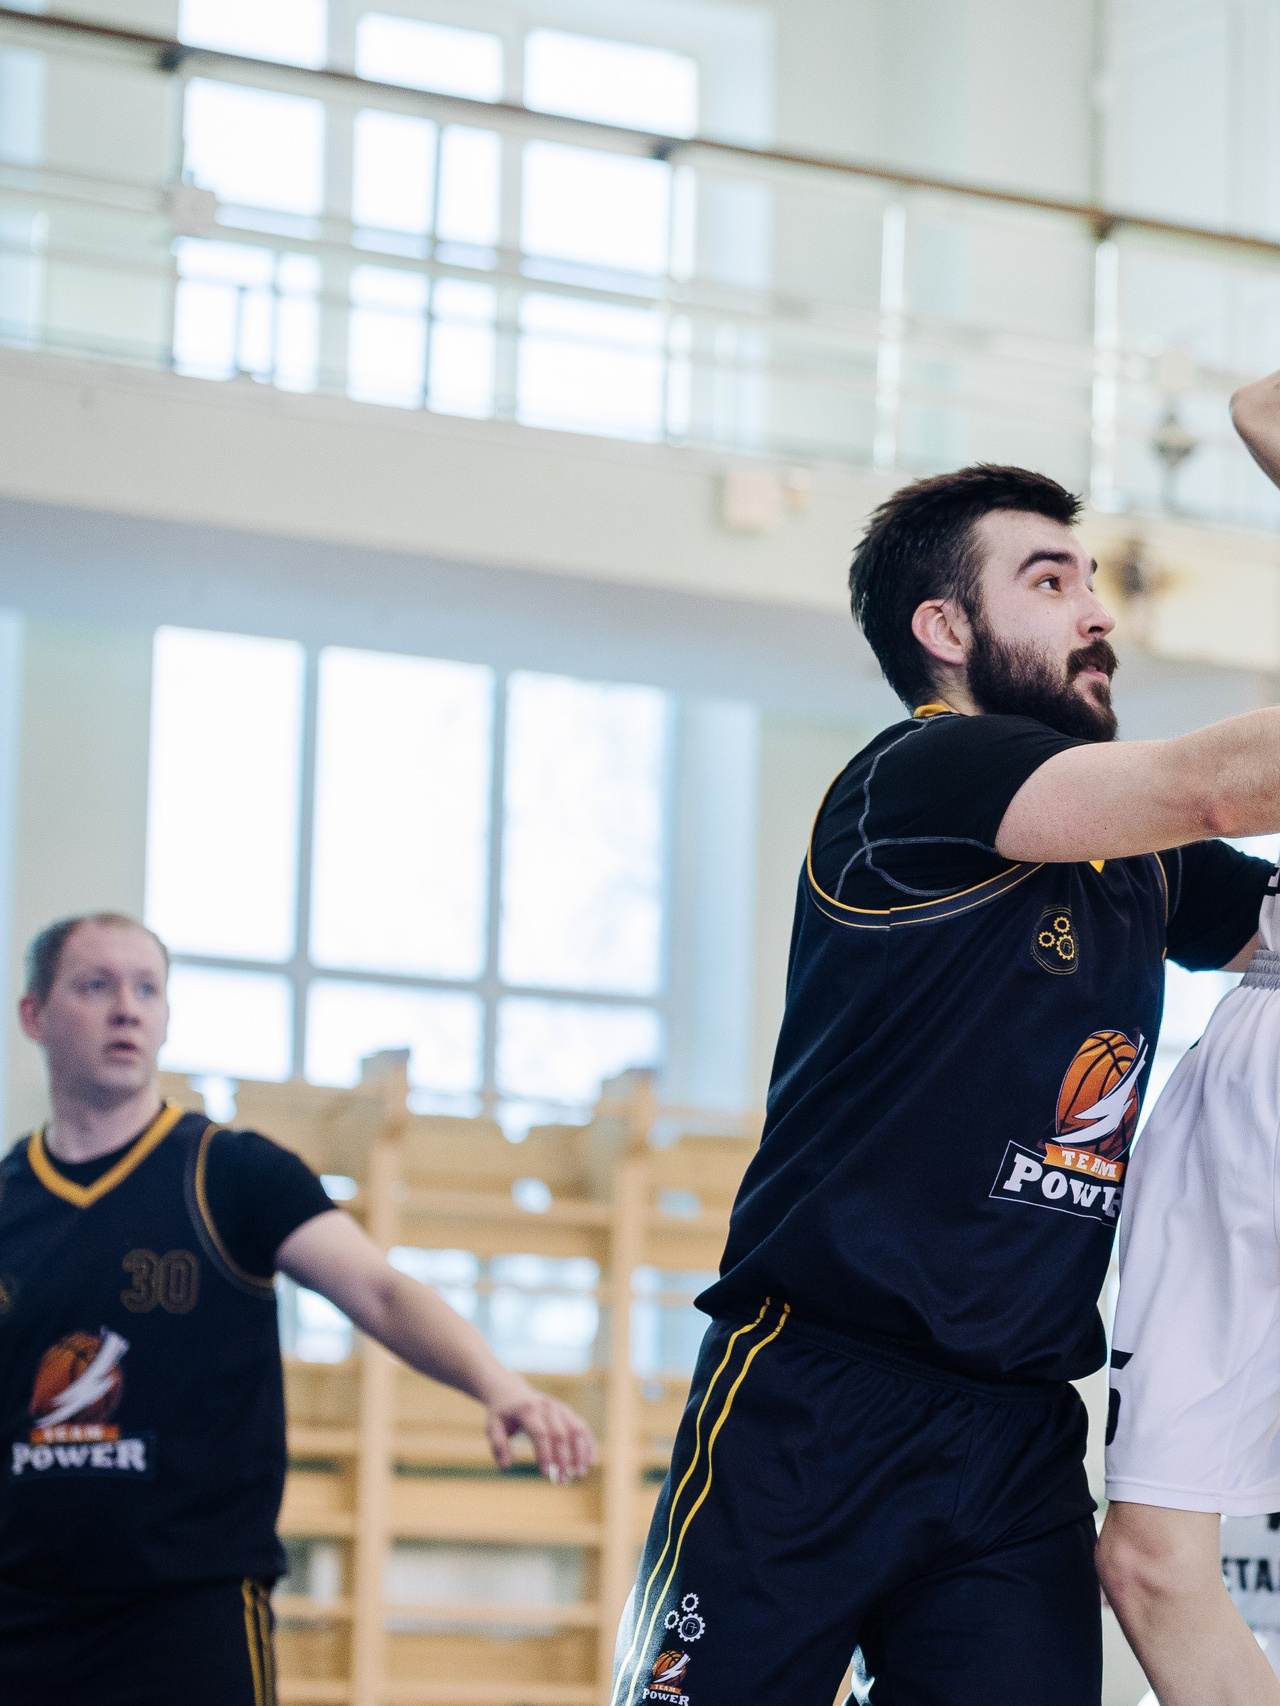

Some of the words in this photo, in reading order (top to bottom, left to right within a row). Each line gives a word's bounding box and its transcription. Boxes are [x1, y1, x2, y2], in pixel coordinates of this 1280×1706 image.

[1061, 1150, 1117, 1178] TEAM
[120, 1248, 199, 1314] 30
[12, 1438, 147, 1475] POWER
[642, 1688, 690, 1706] POWER
[654, 1684, 676, 1693] TEAM
